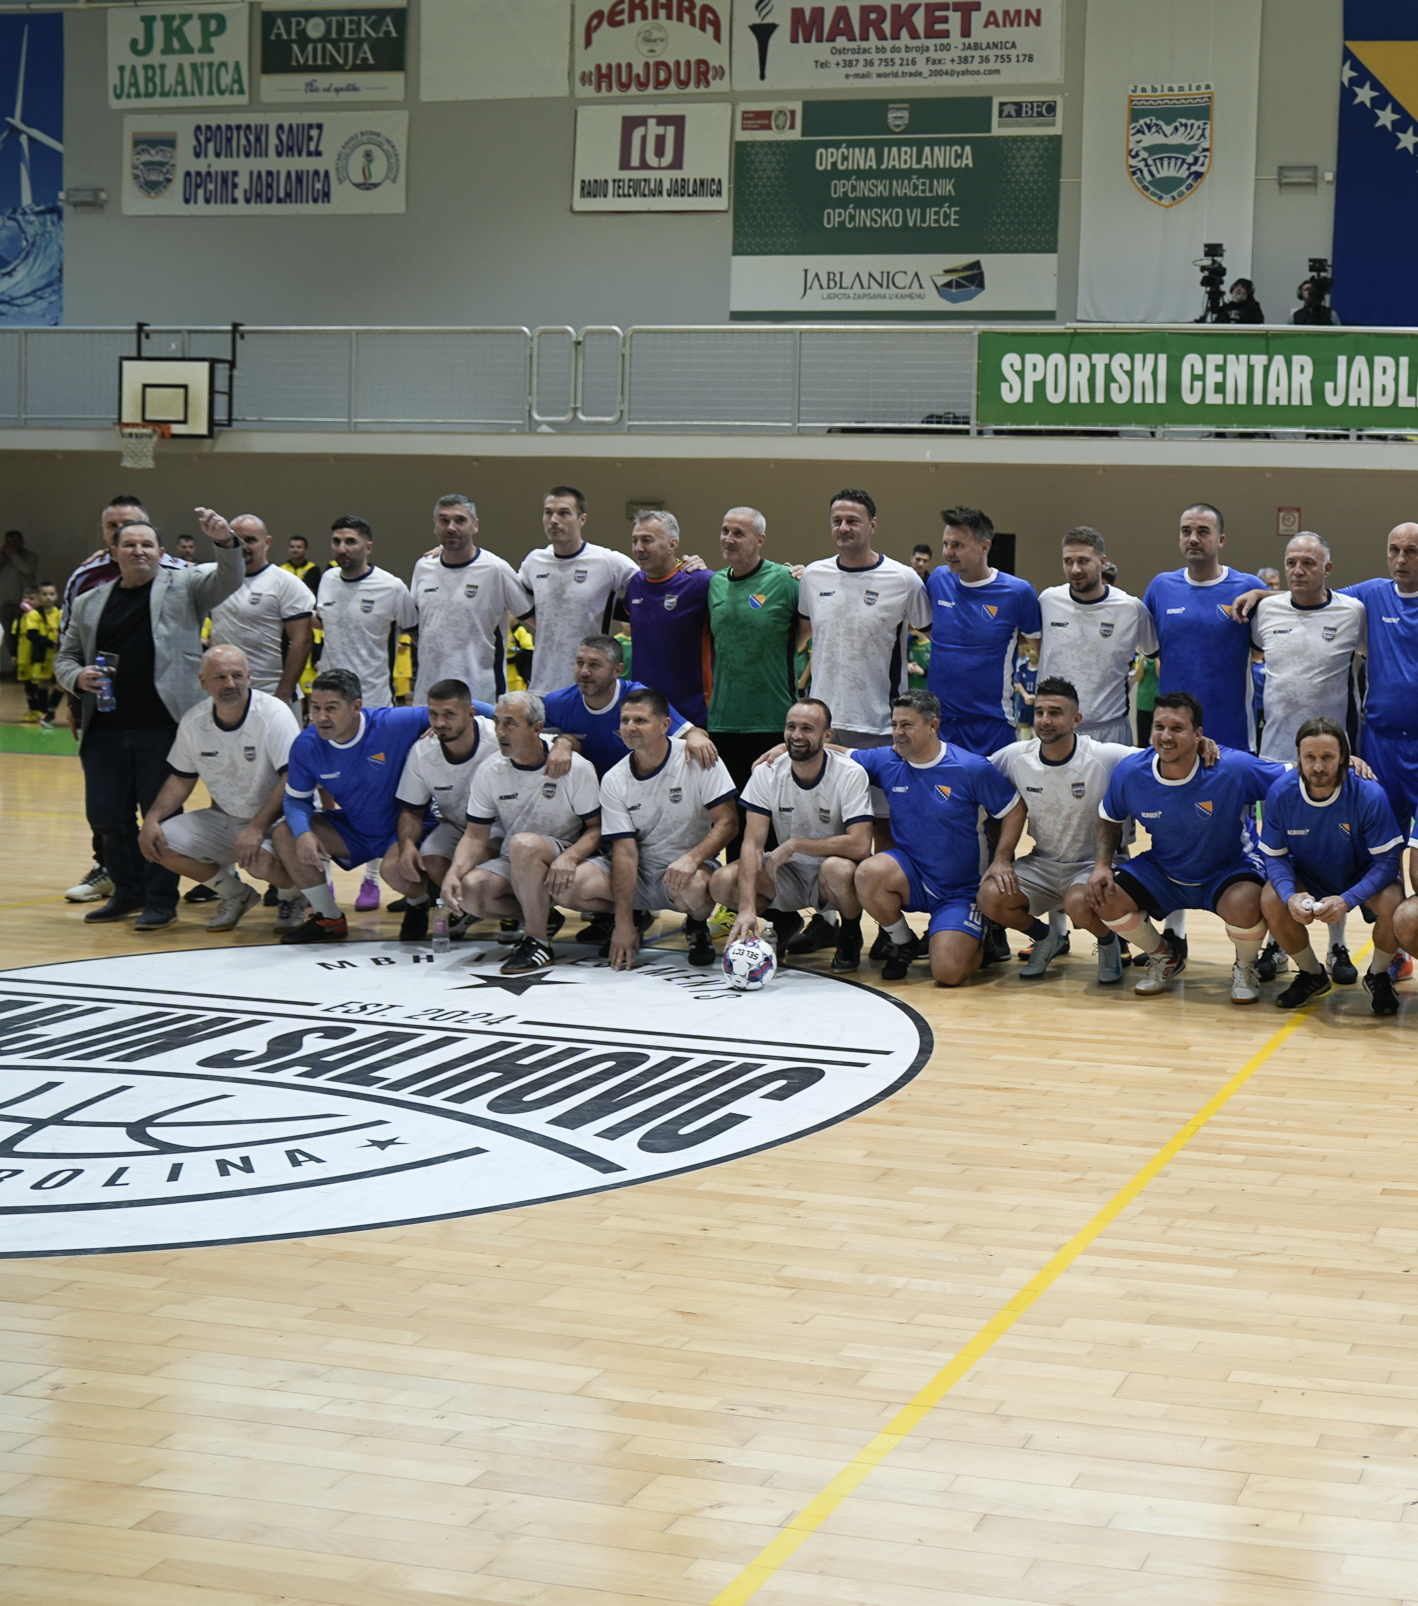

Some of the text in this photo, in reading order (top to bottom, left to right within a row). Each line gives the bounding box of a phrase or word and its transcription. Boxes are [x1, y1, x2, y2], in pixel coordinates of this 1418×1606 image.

[129, 13, 227, 57] JKP
[269, 15, 398, 40] APOTEKA
[584, 0, 722, 50] PEKARA
[790, 1, 1042, 43] MARKET AMN
[290, 42, 376, 70] MINJA
[814, 54, 1034, 69] Tel: +387 36 755 216 Fax: +387 36 755 178
[830, 45, 872, 56] Ostrožac
[875, 44, 887, 55] bb
[890, 44, 902, 54] do
[904, 43, 930, 57] broja
[933, 43, 951, 53] 100
[961, 41, 1017, 52] JABLANICA
[113, 61, 246, 100] JABLANICA
[844, 70, 873, 80] e-mail:
[1131, 83, 1212, 94] Jablanica
[1021, 101, 1055, 117] BFC
[193, 123, 269, 159] SPORTSKI
[275, 122, 324, 158] SAVEZ
[815, 143, 974, 171] OPĆINA JABLANICA
[183, 162, 331, 205] OPĆINE JABLANICA
[580, 177, 722, 199] RADIO TELEVIZIJA JABLANICA
[830, 174, 956, 198] OPĆINSKI NAČELNIK
[823, 202, 961, 228] OPĆINSKO VIJEĆE
[800, 268, 925, 300] JABLANICA
[1000, 352, 1168, 405] SPORTSKI
[1181, 353, 1315, 406] CENTAR
[316, 954, 435, 970] MBH
[320, 1001, 517, 1026] EST. 2024
[195, 1025, 827, 1154] SALIHOVIC
